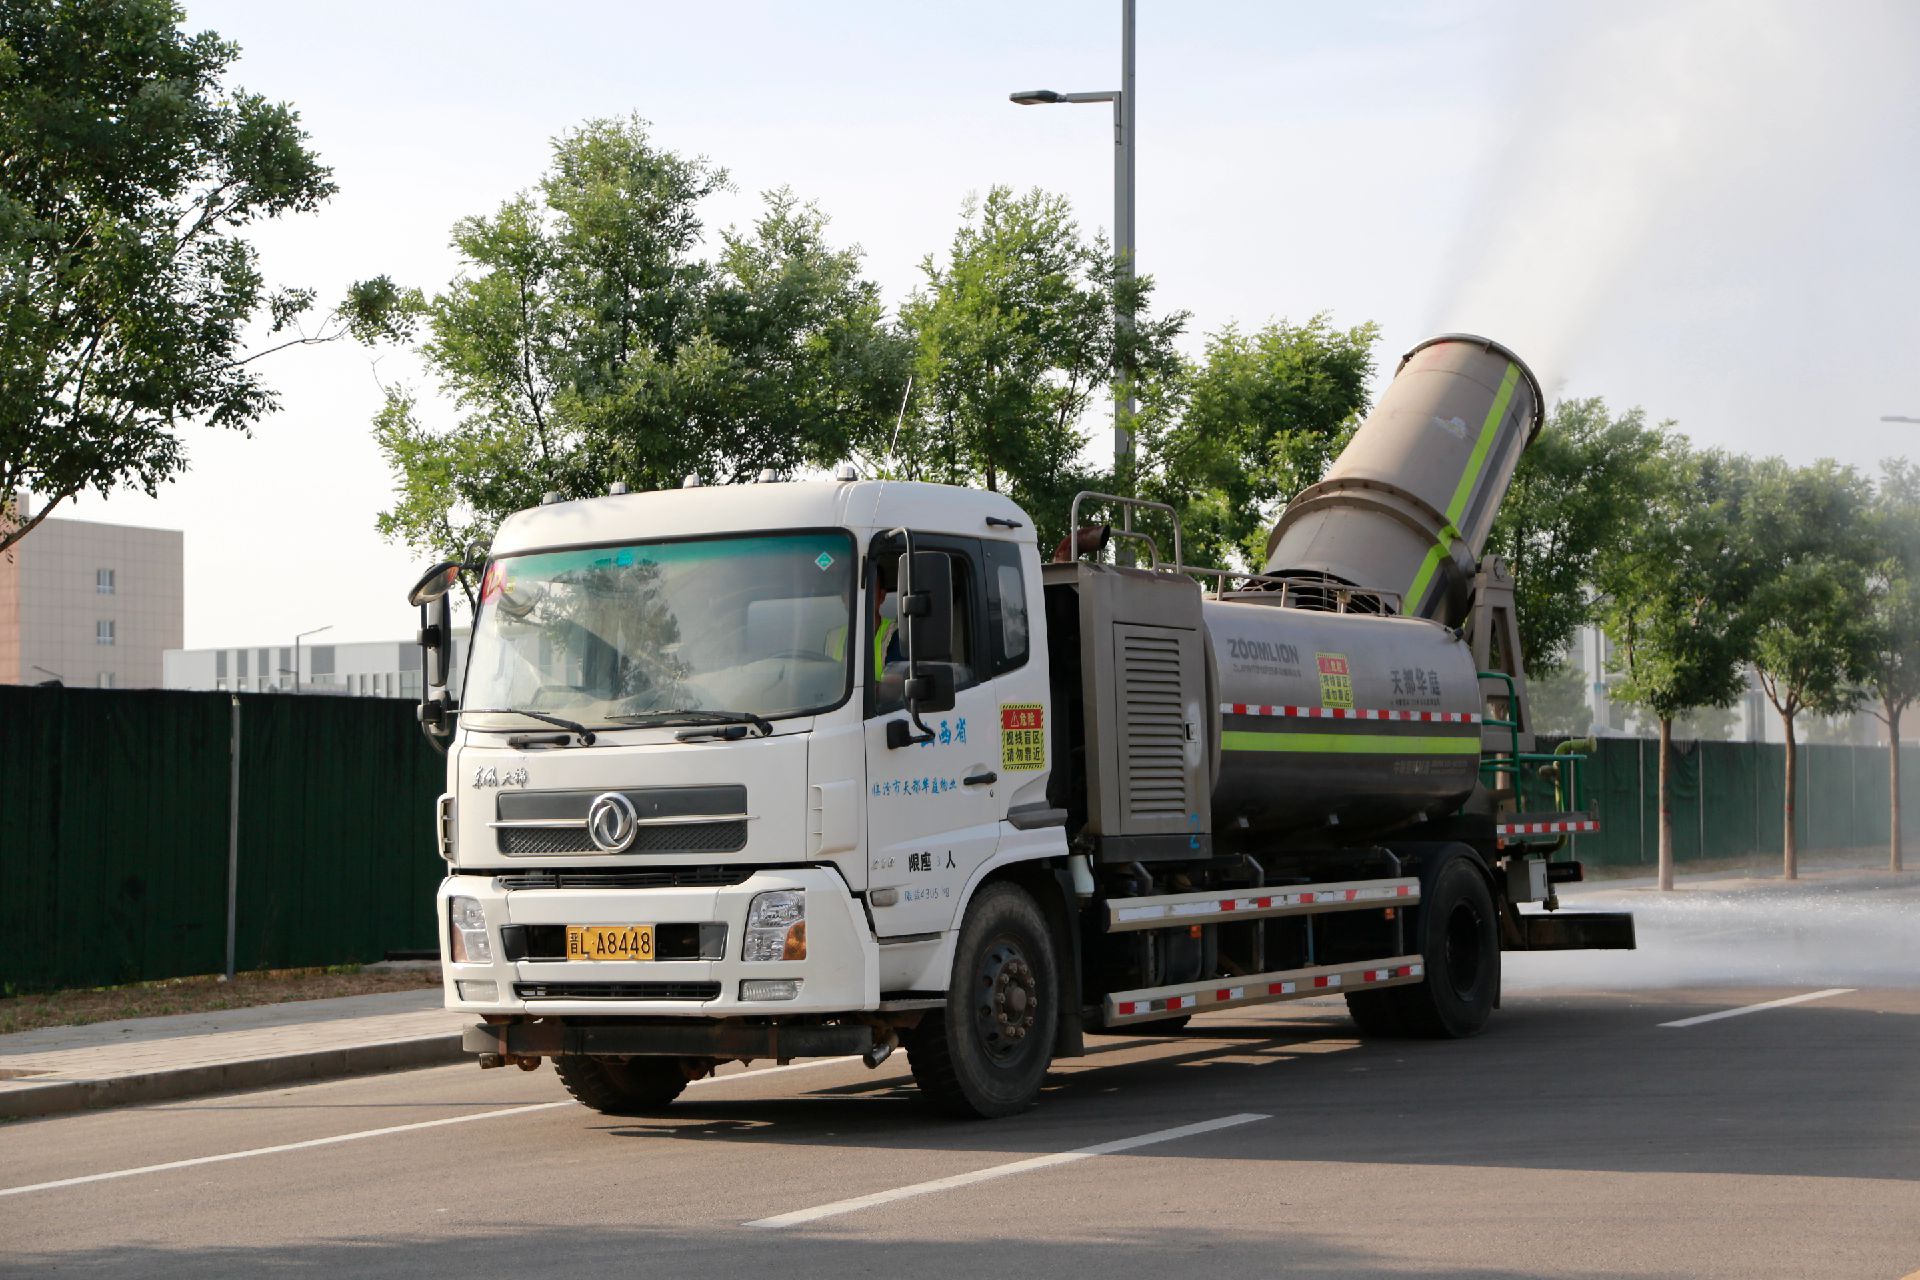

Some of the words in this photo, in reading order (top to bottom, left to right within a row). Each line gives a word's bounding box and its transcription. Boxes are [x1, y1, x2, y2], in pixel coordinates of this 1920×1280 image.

[1226, 638, 1300, 664] ZOOMLION
[1020, 712, 1036, 727] 危险
[1006, 730, 1040, 746] 视线盲区
[1006, 746, 1041, 762] 请勿靠近
